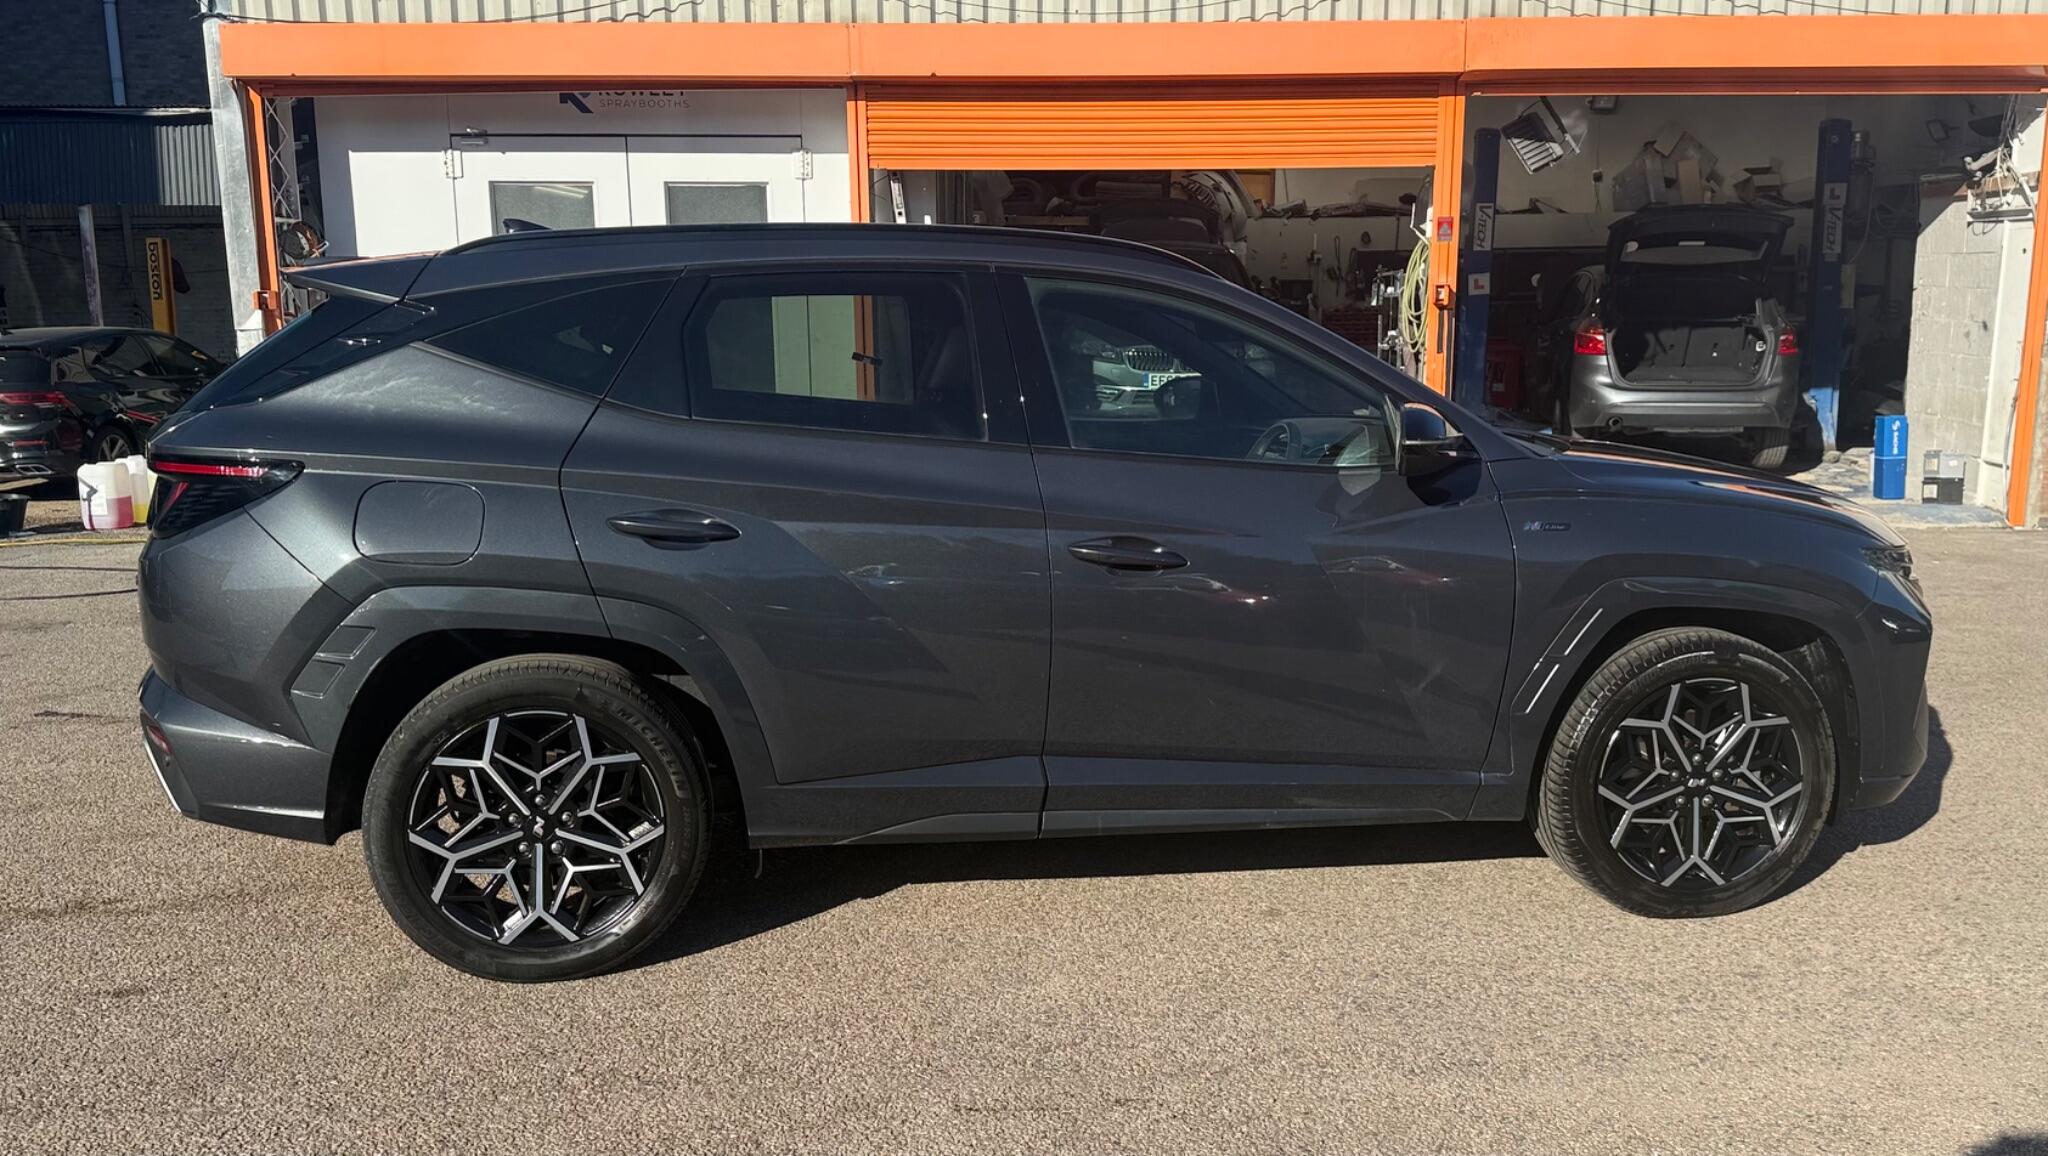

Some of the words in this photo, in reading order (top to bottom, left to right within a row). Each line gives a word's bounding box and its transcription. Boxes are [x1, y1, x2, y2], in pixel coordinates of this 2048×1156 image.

[599, 99, 690, 108] SPRAYBOOTHS
[1476, 205, 1492, 249] V-TECH
[148, 242, 161, 300] boston
[616, 706, 690, 794] MICHELIN
